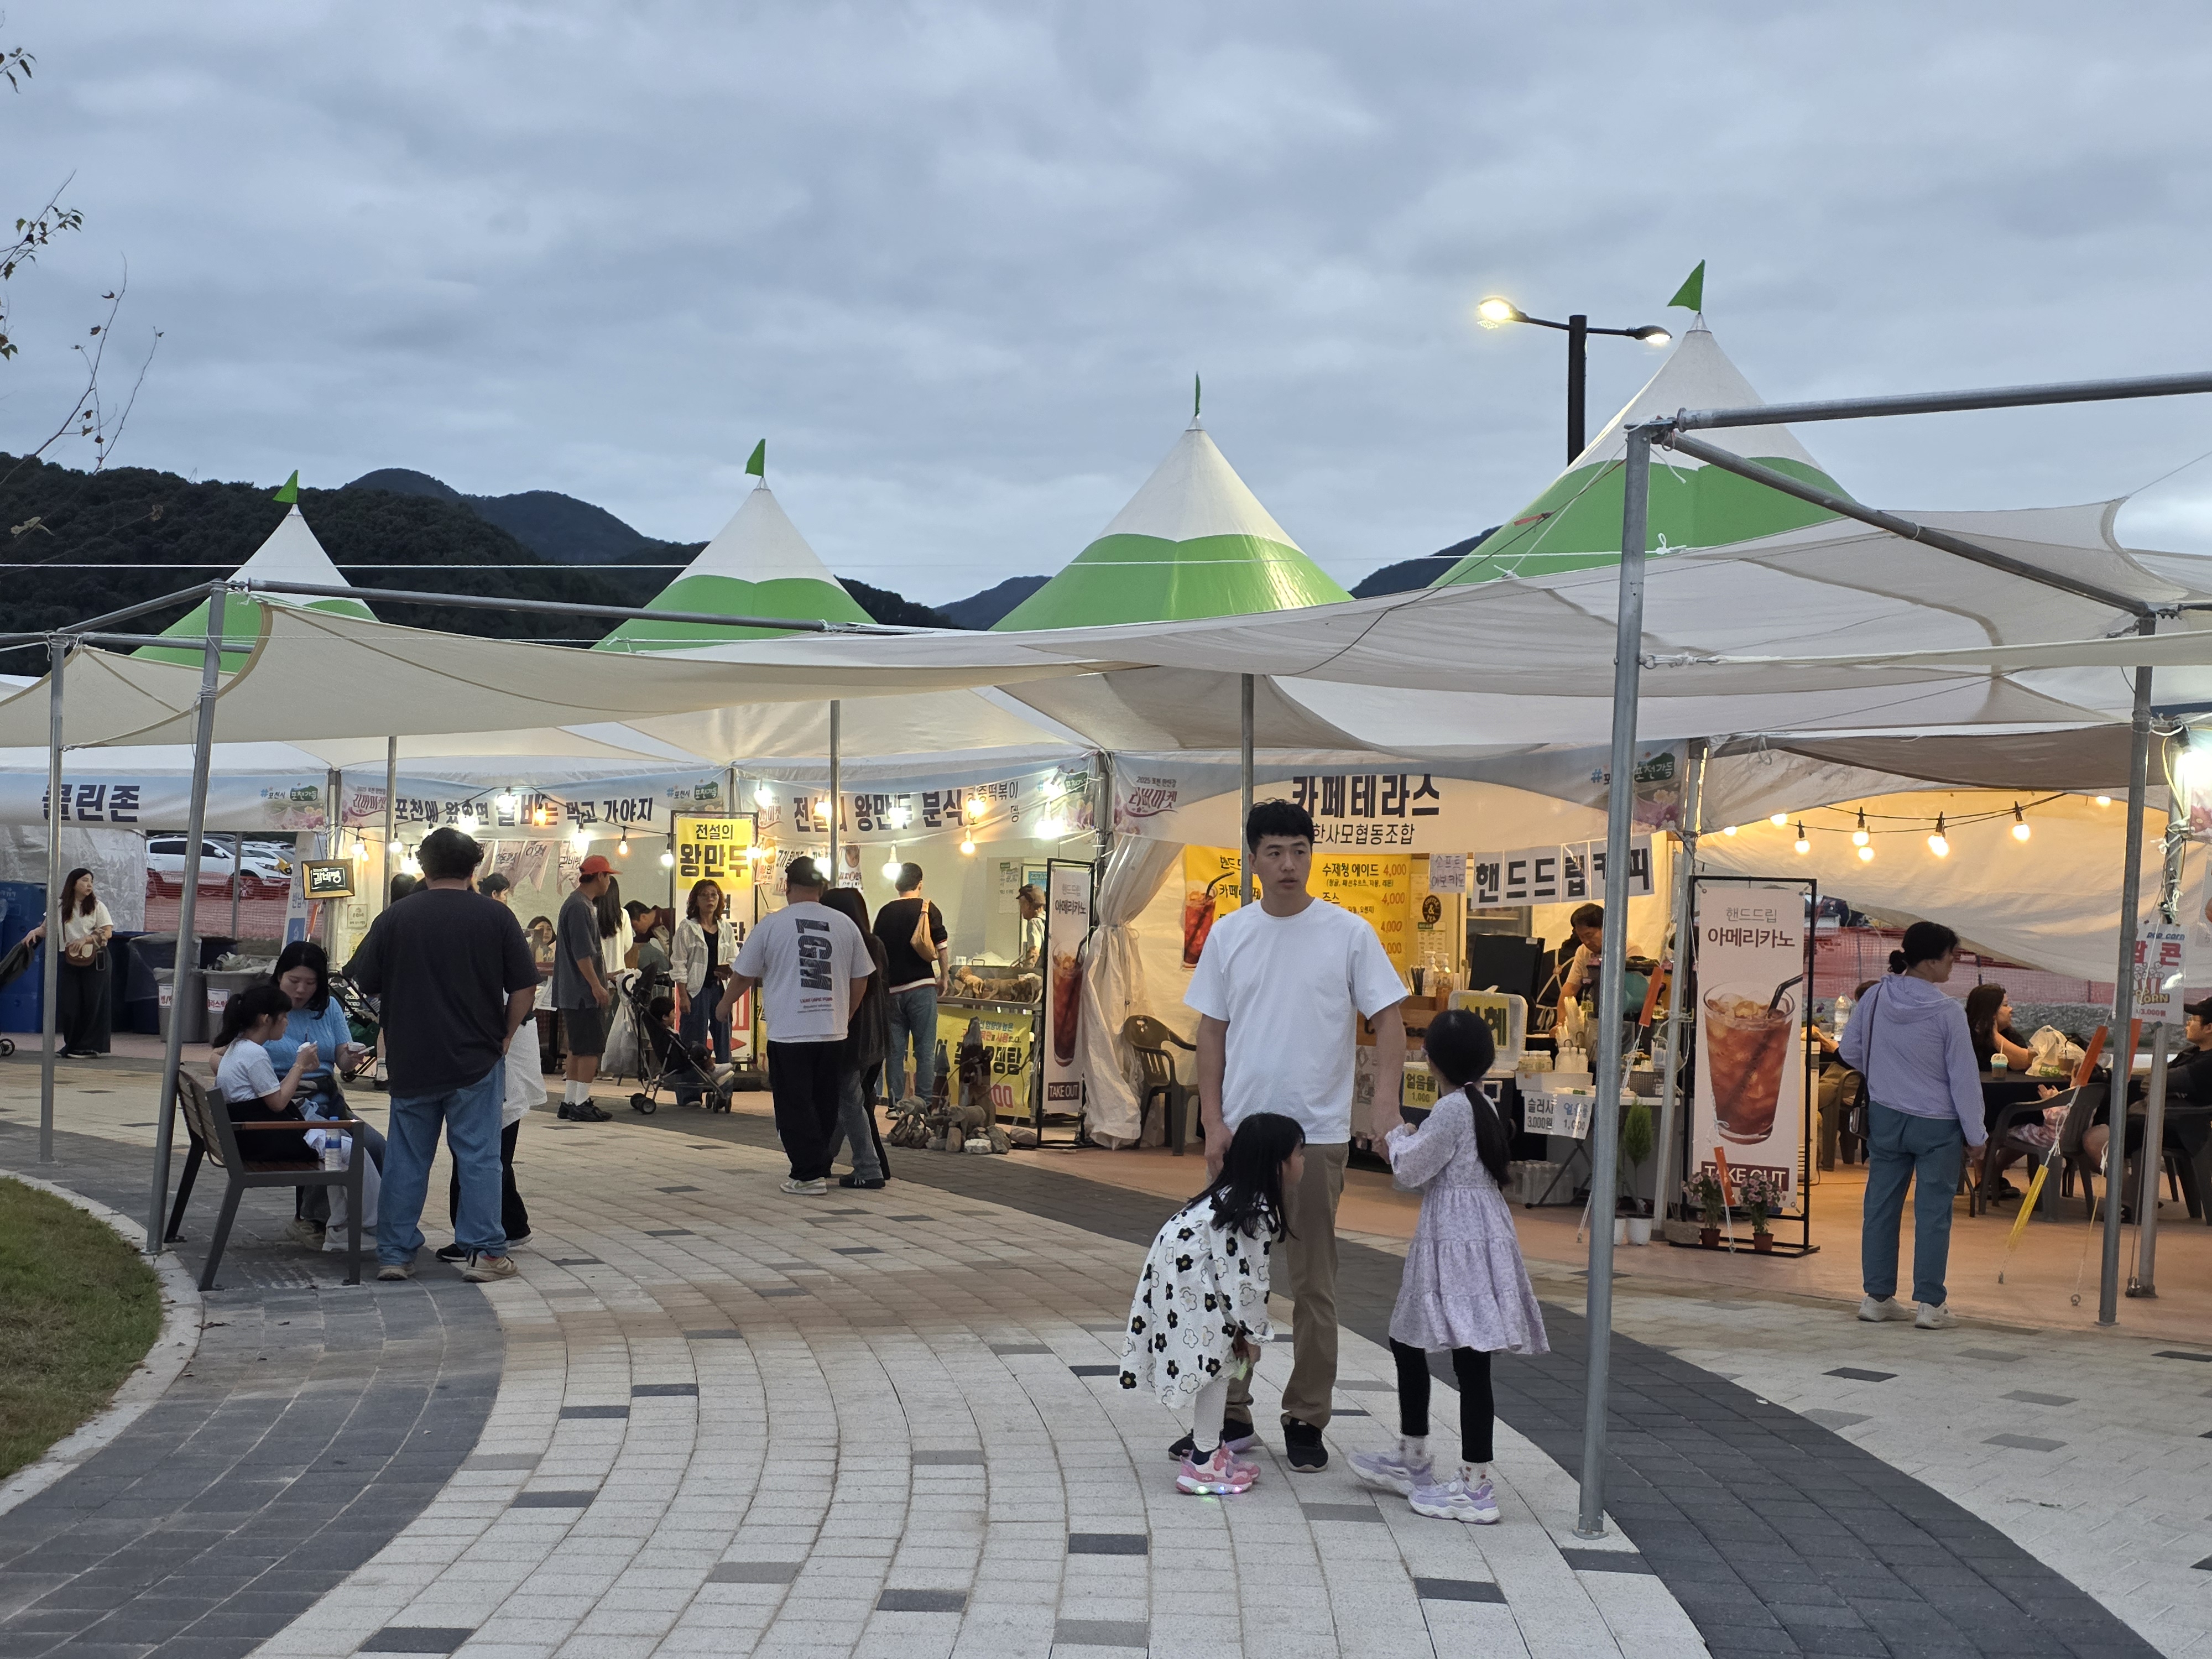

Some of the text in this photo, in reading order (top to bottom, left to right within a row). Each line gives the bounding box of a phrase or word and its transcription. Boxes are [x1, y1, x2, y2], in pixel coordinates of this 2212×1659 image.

[42, 784, 140, 822] 클린존
[1292, 774, 1439, 818] 카페테라스
[395, 799, 439, 823] 포천에
[566, 801, 598, 825] 먹고
[603, 797, 653, 823] 가야지
[854, 794, 912, 831] 왕만두
[922, 790, 963, 827] 분식
[696, 824, 733, 840] 전설의
[680, 843, 748, 877] 왕만두
[1352, 863, 1379, 877] 에이드
[1383, 863, 1407, 878] 4,000
[1381, 891, 1405, 906] 4,000
[1726, 907, 1777, 923] 핸드드립
[1381, 920, 1402, 933] 4,000
[1708, 927, 1795, 948] 아메리카노
[795, 918, 832, 991] LGM
[2137, 994, 2169, 1004] CORN
[1050, 1084, 1078, 1098] TAKE OUT
[1412, 1092, 1430, 1102] 1,000
[1704, 1165, 1746, 1184] TKE
